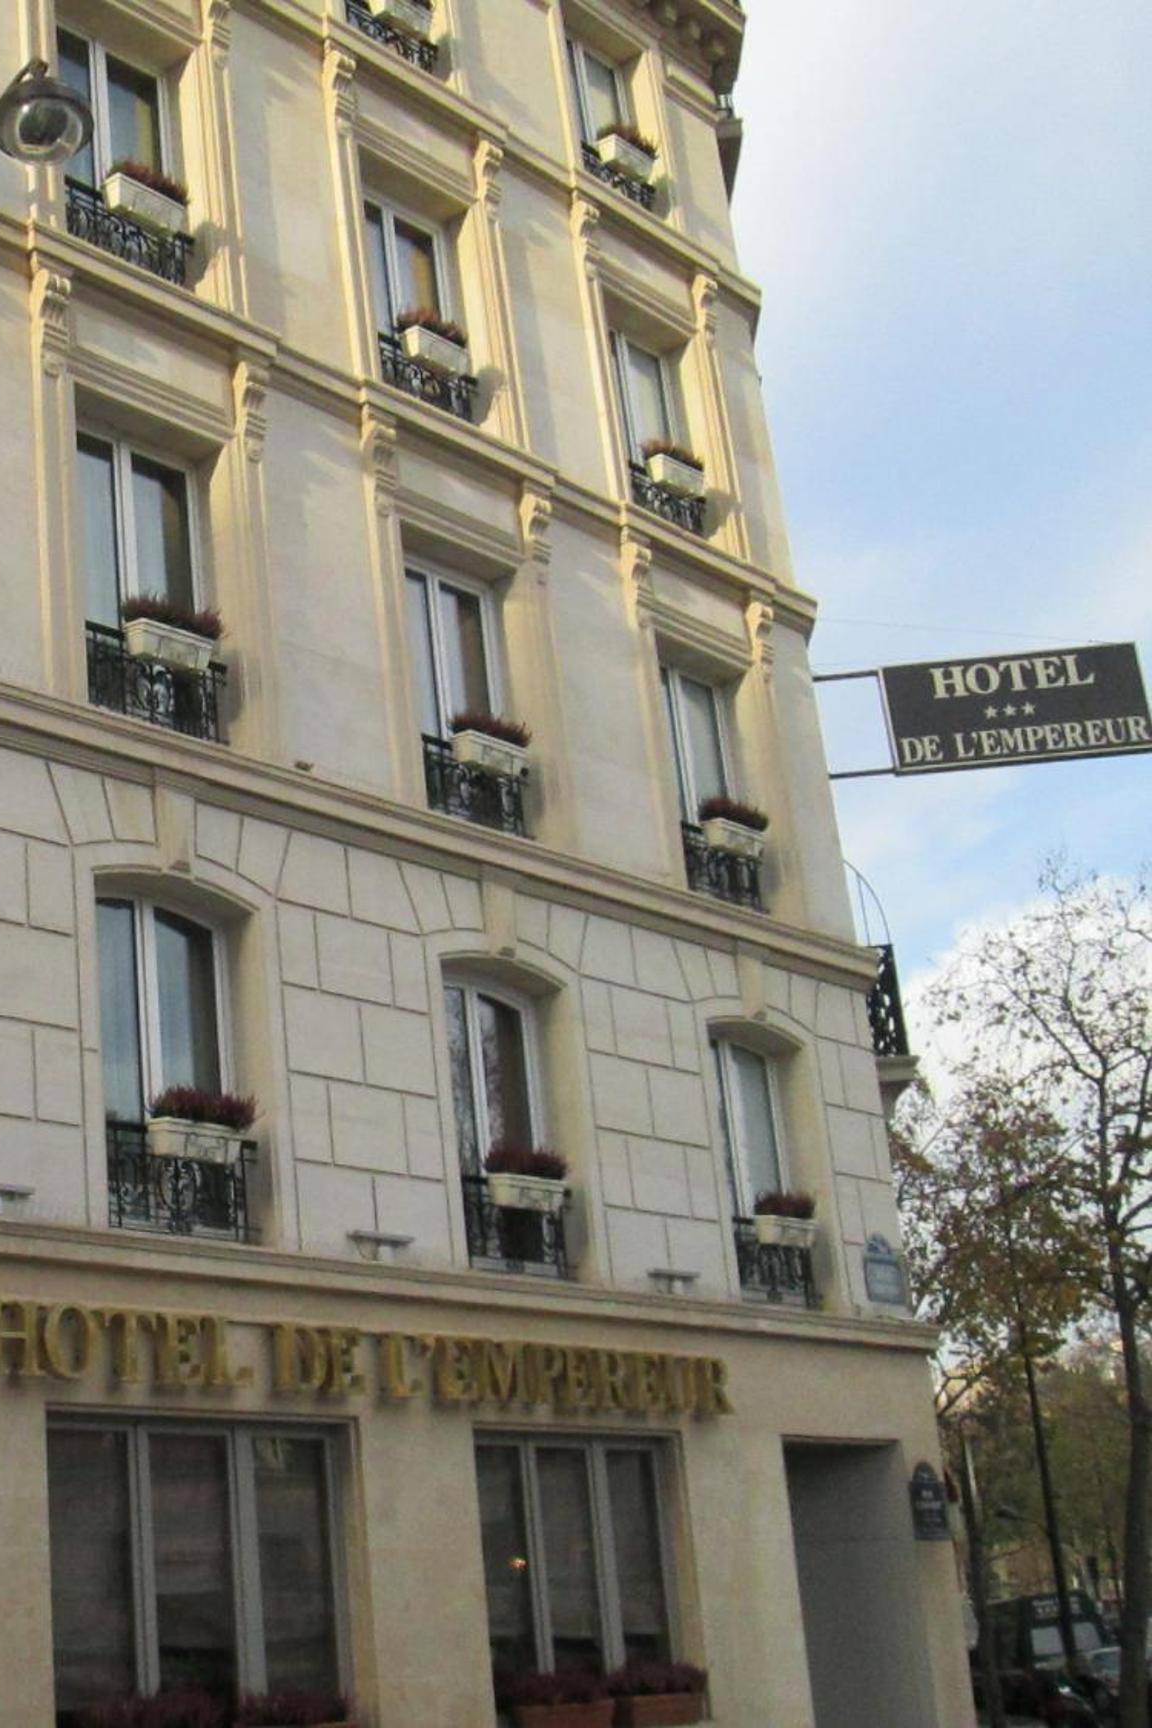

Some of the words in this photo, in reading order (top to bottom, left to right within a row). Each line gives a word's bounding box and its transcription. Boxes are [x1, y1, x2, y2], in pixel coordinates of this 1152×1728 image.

[929, 655, 1094, 699] HOTEL
[900, 735, 943, 763] DE
[955, 716, 1149, 758] L'EMPEREUR
[275, 1321, 365, 1395] DE
[380, 1331, 736, 1417] L'EMPEREUR
